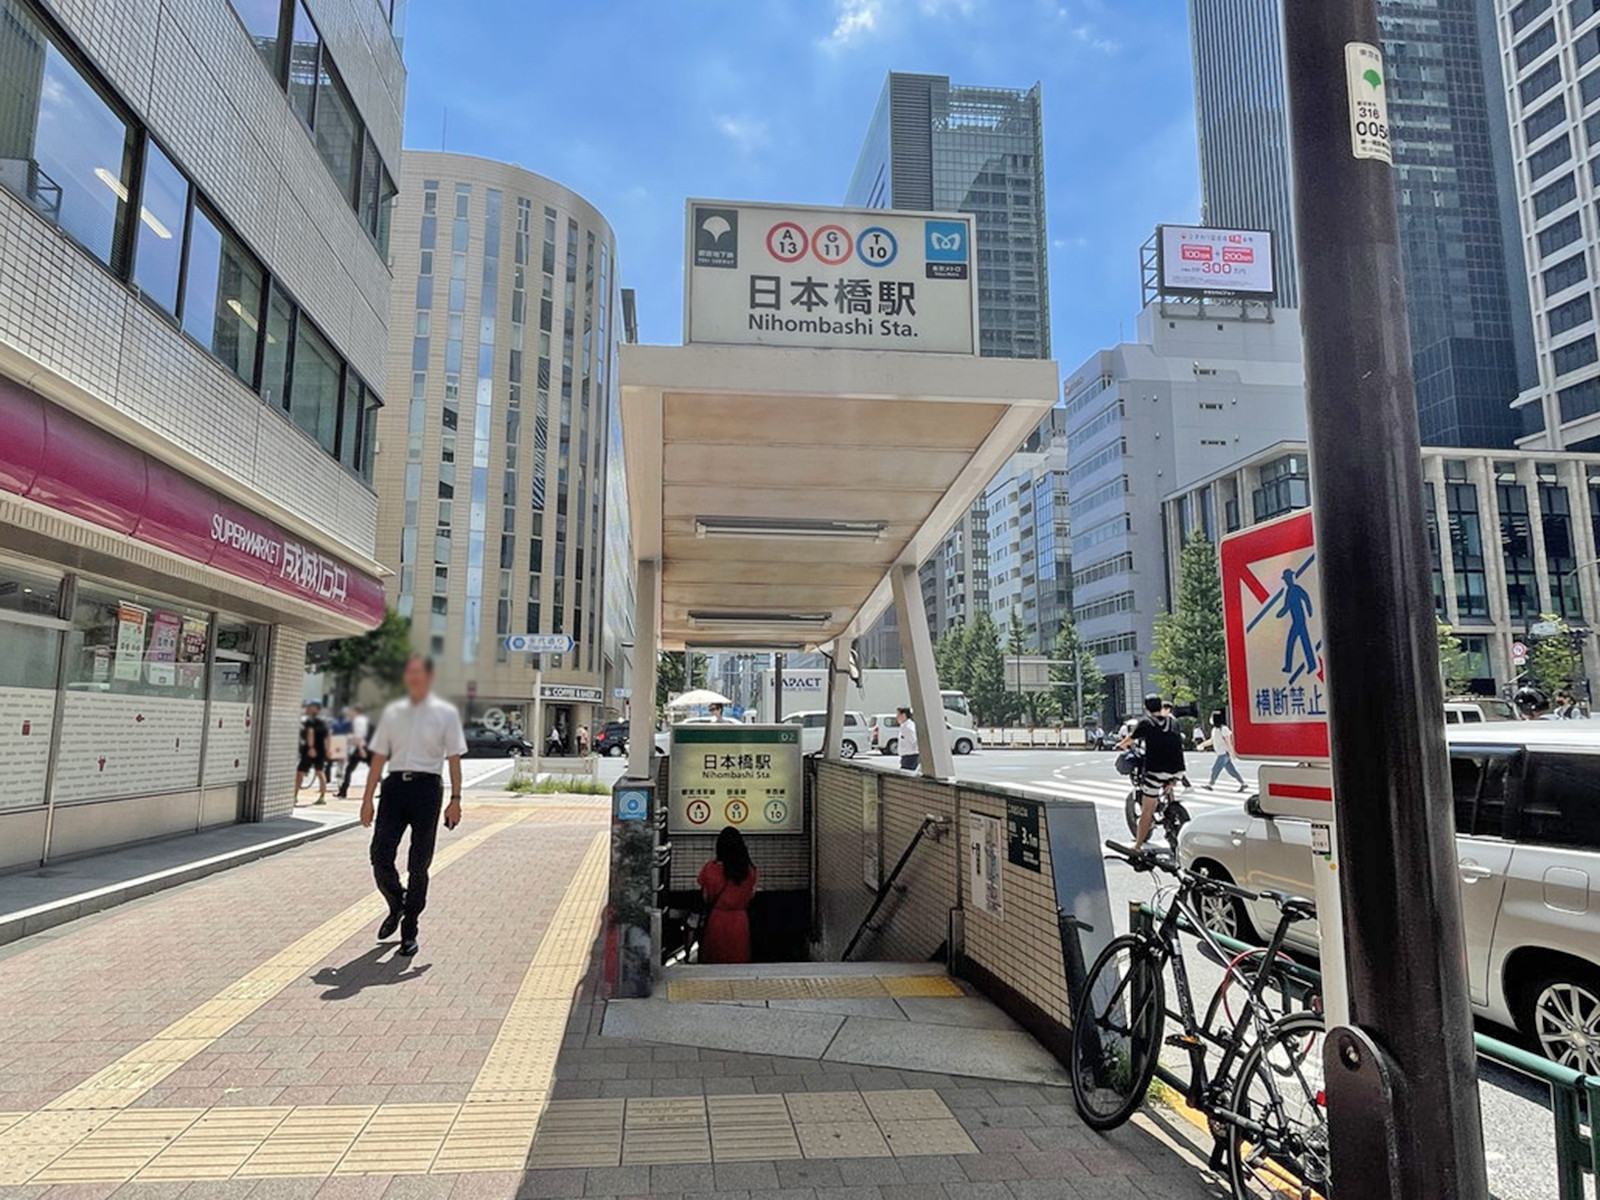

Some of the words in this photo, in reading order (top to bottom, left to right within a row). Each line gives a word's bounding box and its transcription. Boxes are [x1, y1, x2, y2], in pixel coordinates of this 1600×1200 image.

[782, 229, 793, 241] A
[826, 231, 838, 243] G
[873, 234, 881, 245] T
[779, 241, 797, 254] 13
[825, 244, 840, 256] 11
[869, 246, 887, 259] 10
[749, 274, 916, 317] 日本橋駅
[748, 313, 873, 336] Nihombashi
[880, 319, 918, 337] Sta.
[211, 513, 281, 566] SUPERMARKET
[1256, 684, 1326, 716] 横断禁止
[704, 754, 771, 770] 日本橋駅
[702, 771, 754, 779] Nihombashi
[693, 811, 705, 819] 13
[732, 811, 742, 819] 11
[770, 811, 782, 819] 10
